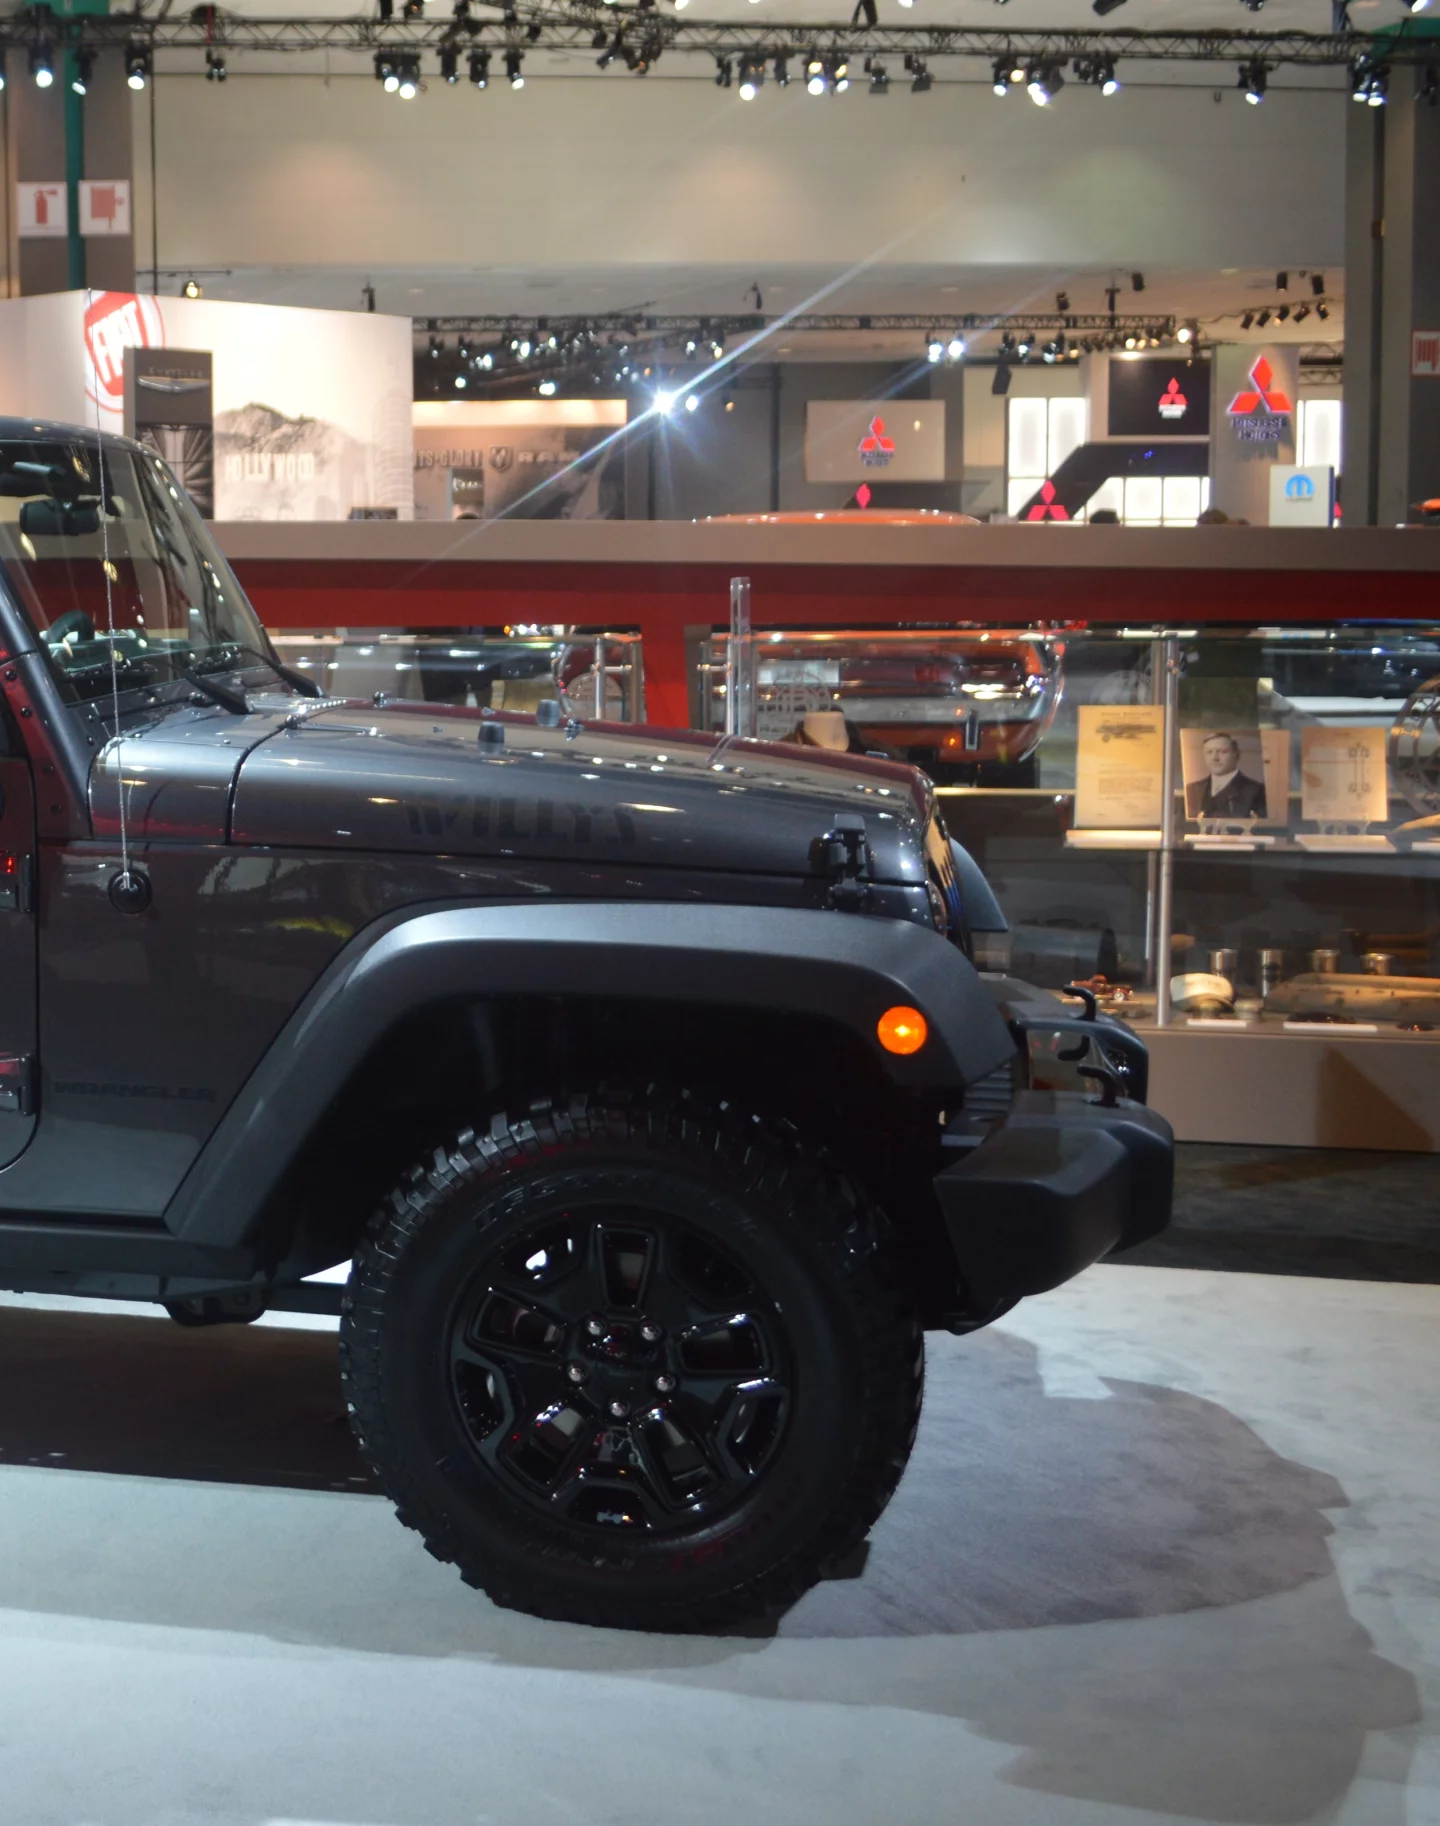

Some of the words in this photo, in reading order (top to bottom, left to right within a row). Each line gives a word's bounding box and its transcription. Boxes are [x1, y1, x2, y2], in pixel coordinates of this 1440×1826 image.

[225, 452, 316, 483] HOLLYWOOD
[517, 450, 581, 463] RAM
[405, 793, 637, 846] WILLYS
[52, 1080, 217, 1103] WRANGLER
